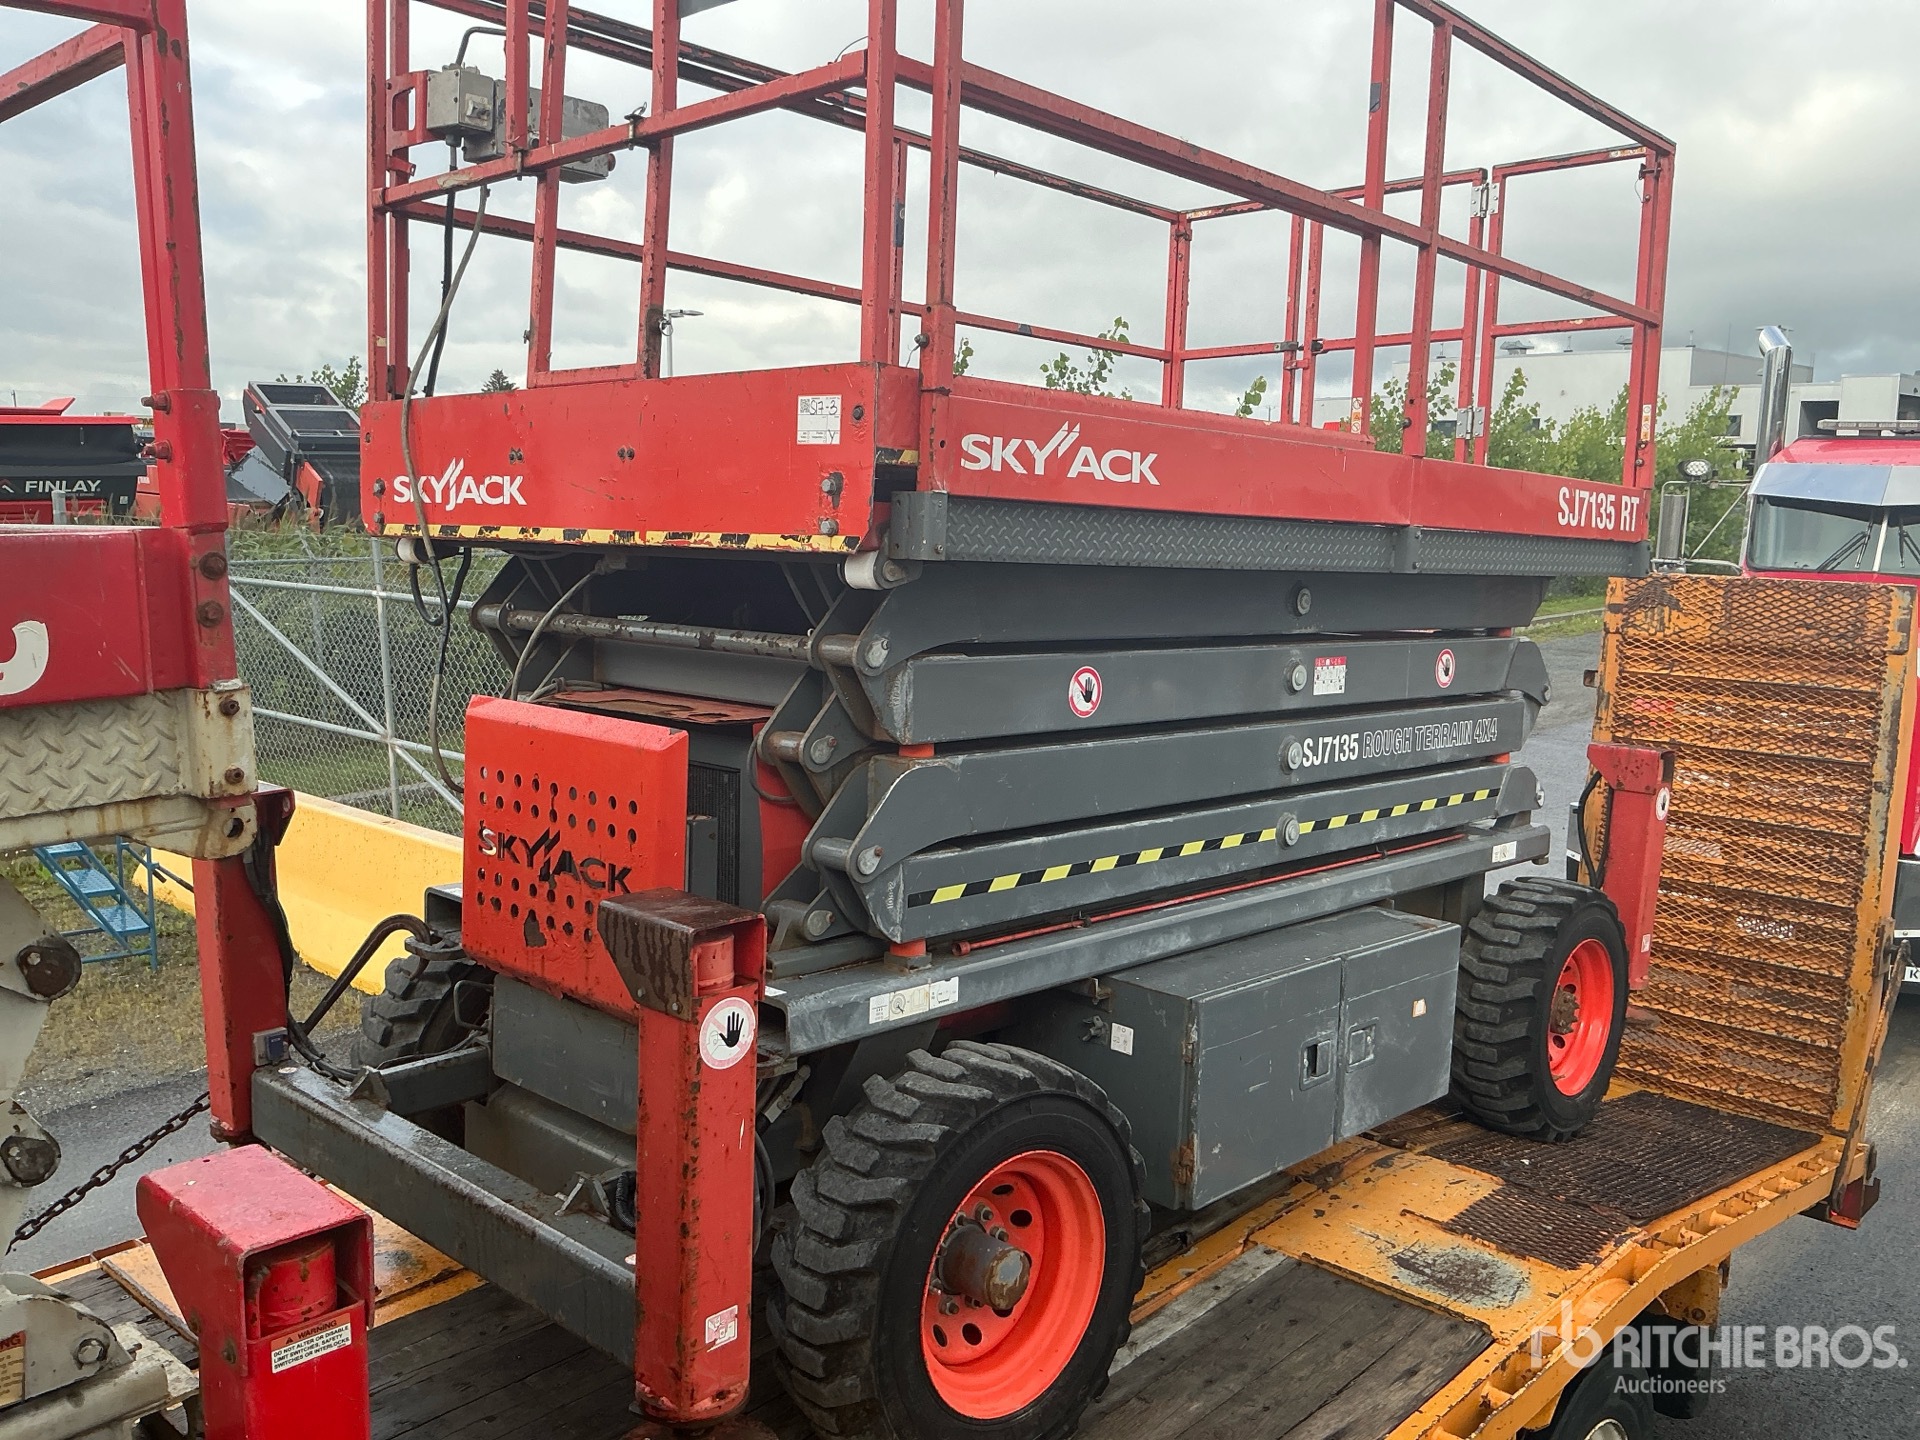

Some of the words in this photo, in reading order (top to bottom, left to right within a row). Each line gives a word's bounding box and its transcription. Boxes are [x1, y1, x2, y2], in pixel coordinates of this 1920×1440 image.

[25, 480, 101, 493] FINLAY
[393, 457, 527, 511] SKYJACK
[1558, 486, 1616, 531] SJ7135
[1620, 495, 1640, 532] RT
[1302, 732, 1359, 768] SJ7135
[1362, 727, 1413, 759] ROUGH
[1415, 720, 1473, 752] TERRAIN
[1473, 717, 1498, 742] 4X4
[478, 826, 633, 894] SKYJACK
[296, 1339, 314, 1348] ALTER
[326, 1326, 348, 1337] DISABLE
[298, 1320, 337, 1338] WARNING
[274, 1354, 289, 1363] LIMIT
[322, 1334, 342, 1344] SAFETY
[274, 1356, 304, 1370] SWITCHES
[305, 1350, 313, 1358] OR
[314, 1337, 350, 1353] INTERLOCKS
